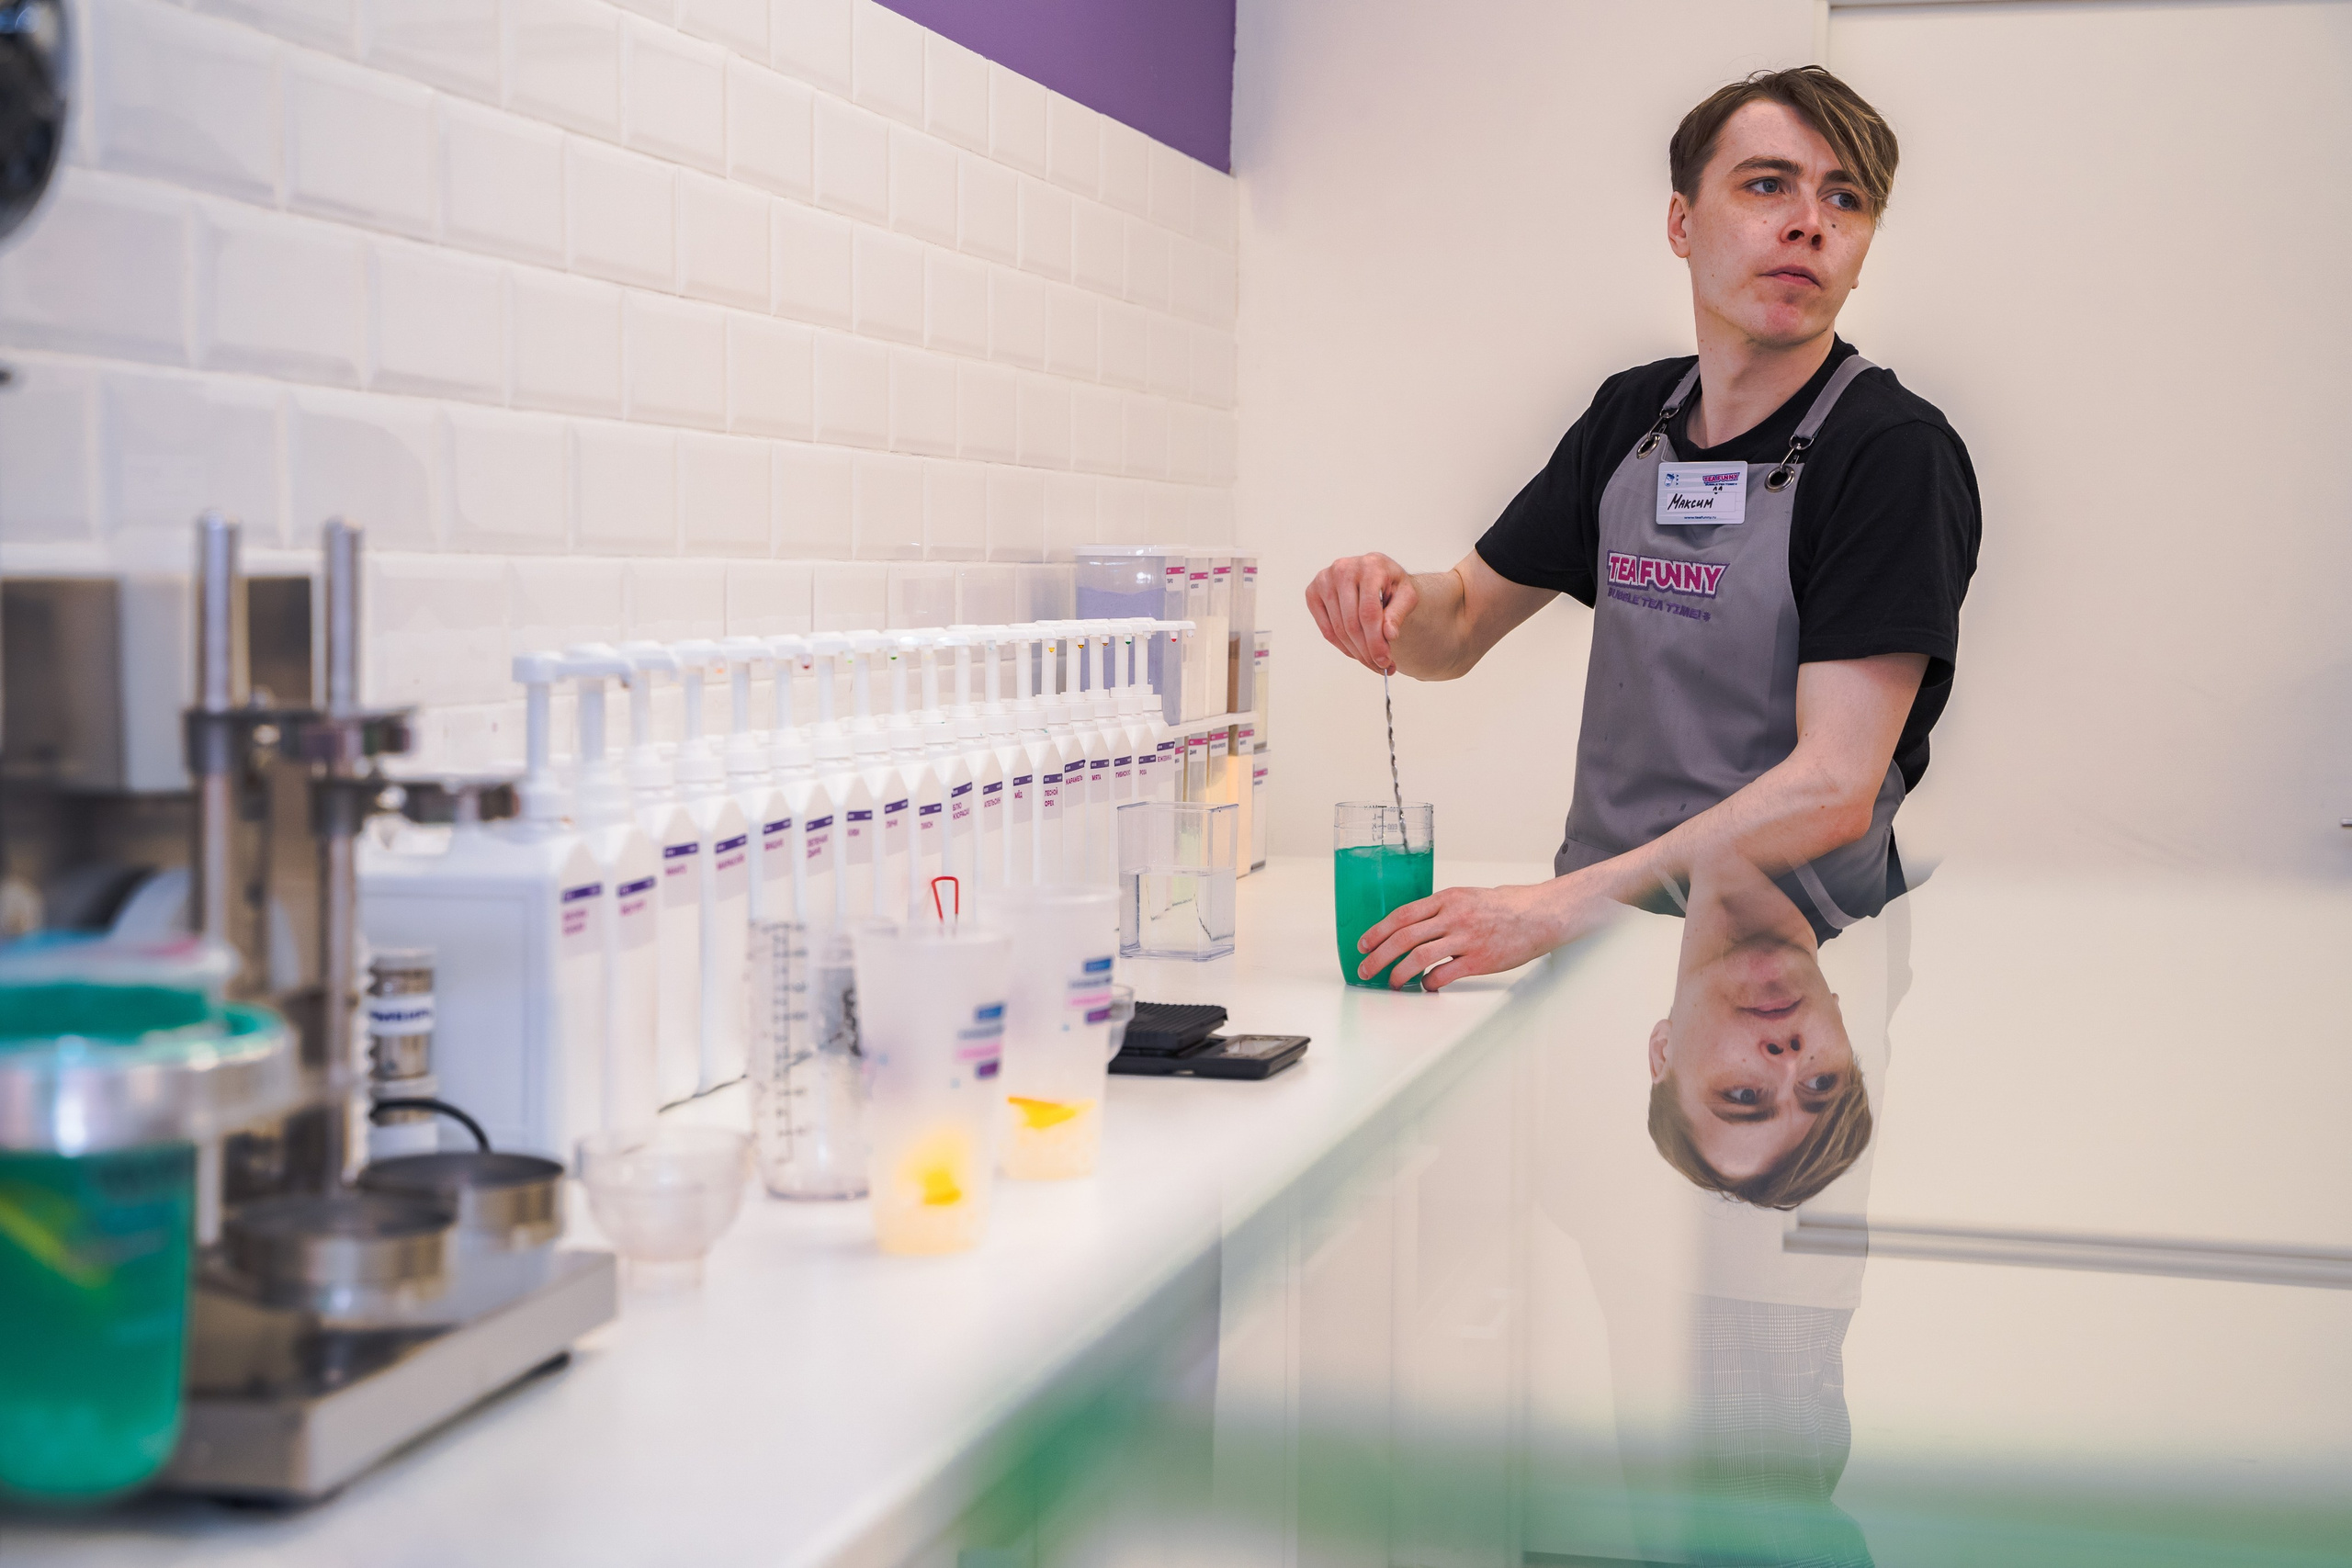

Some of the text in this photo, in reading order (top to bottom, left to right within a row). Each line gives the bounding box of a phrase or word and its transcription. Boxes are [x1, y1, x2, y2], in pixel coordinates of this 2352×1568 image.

[1702, 472, 1739, 483] TEA FUNNY
[1609, 553, 1725, 595] TEA FUNNY
[1608, 587, 1639, 605] BUBBLE
[1642, 596, 1663, 612] TEA
[1066, 774, 1083, 785] КАРАМЕЛЬ
[1045, 786, 1058, 796] ЛЕСНОЙ
[953, 802, 962, 811] БЛЮ
[984, 797, 1001, 808] АПЕЛЬСИН
